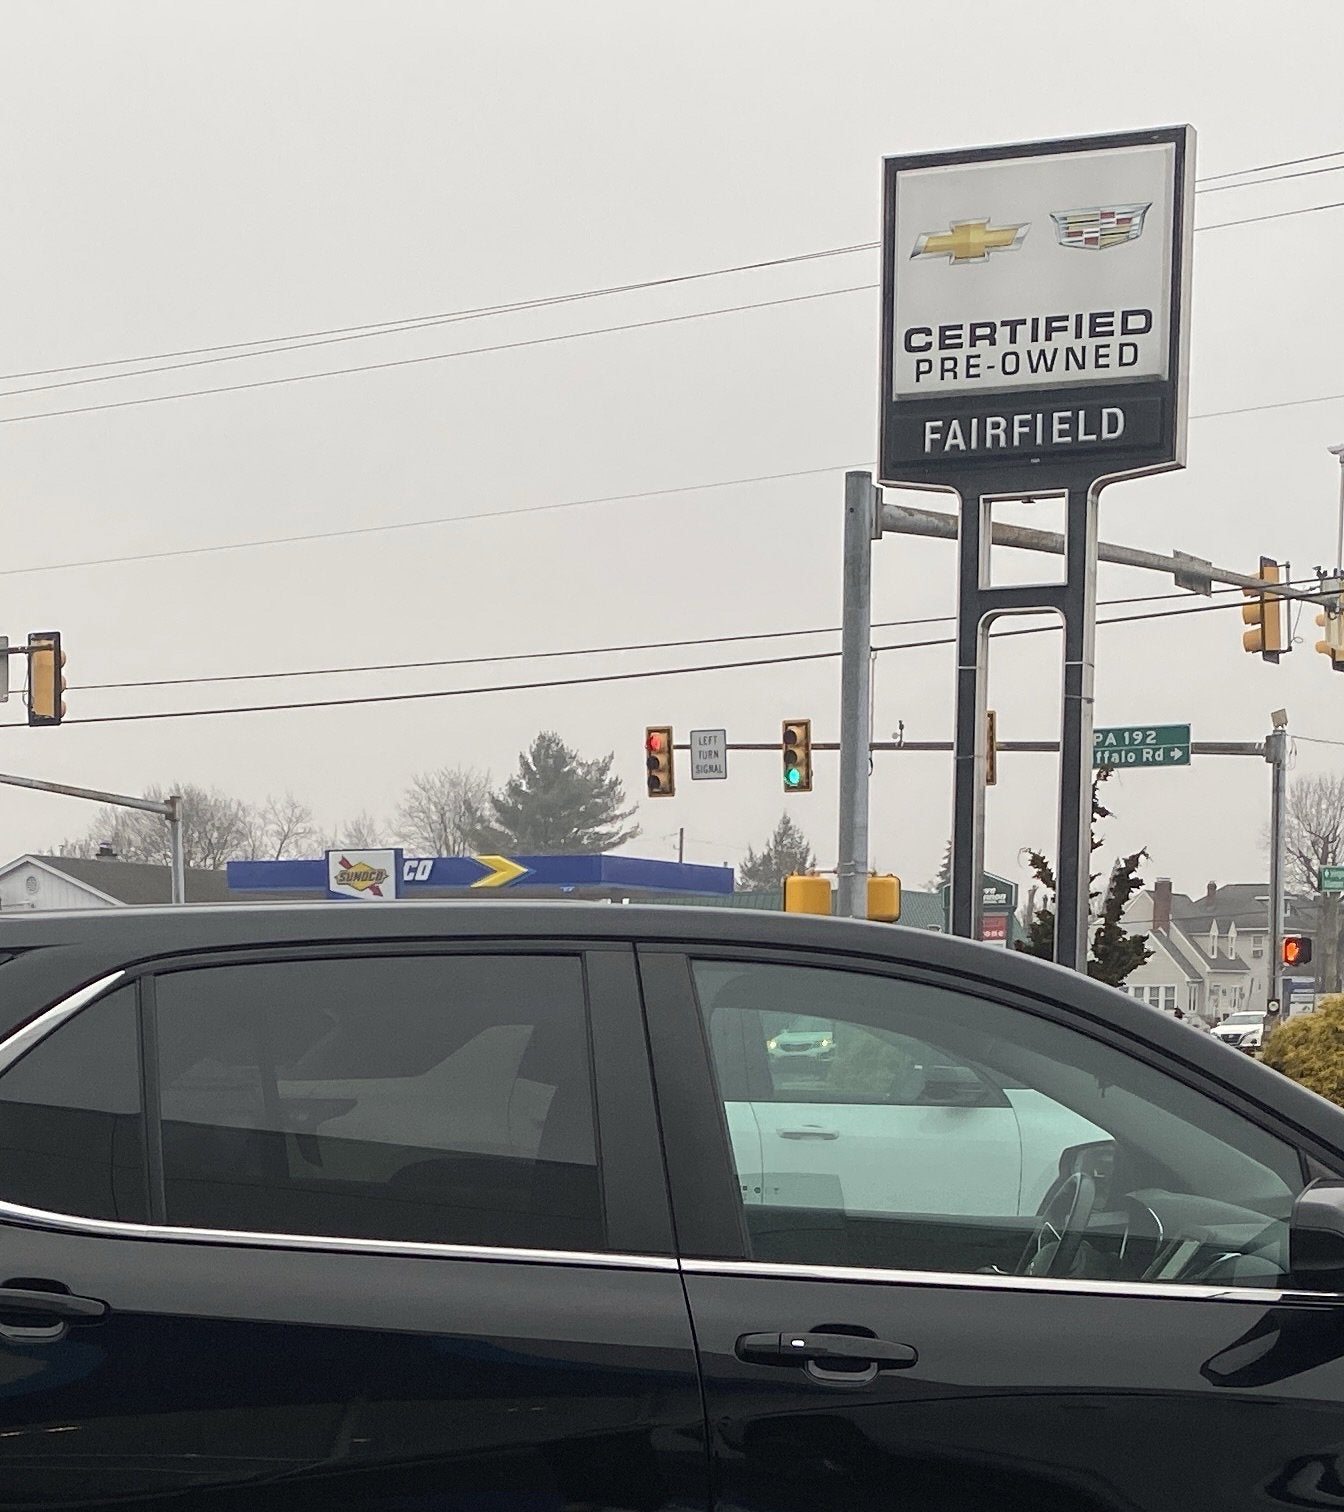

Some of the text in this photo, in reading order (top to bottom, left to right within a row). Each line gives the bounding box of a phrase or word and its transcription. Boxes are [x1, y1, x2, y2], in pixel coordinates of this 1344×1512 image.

[904, 308, 1153, 353] CERTIFIED
[915, 342, 1139, 382] PRE-OWNED
[923, 407, 1126, 453] FAIRFIELD
[698, 736, 718, 746] LEFT
[1093, 731, 1157, 746] PA 192
[698, 750, 719, 760] TURN
[1142, 748, 1164, 762] Rd
[695, 764, 723, 774] SIGNAL
[338, 870, 384, 882] SUNOCO
[403, 860, 434, 881] CO
